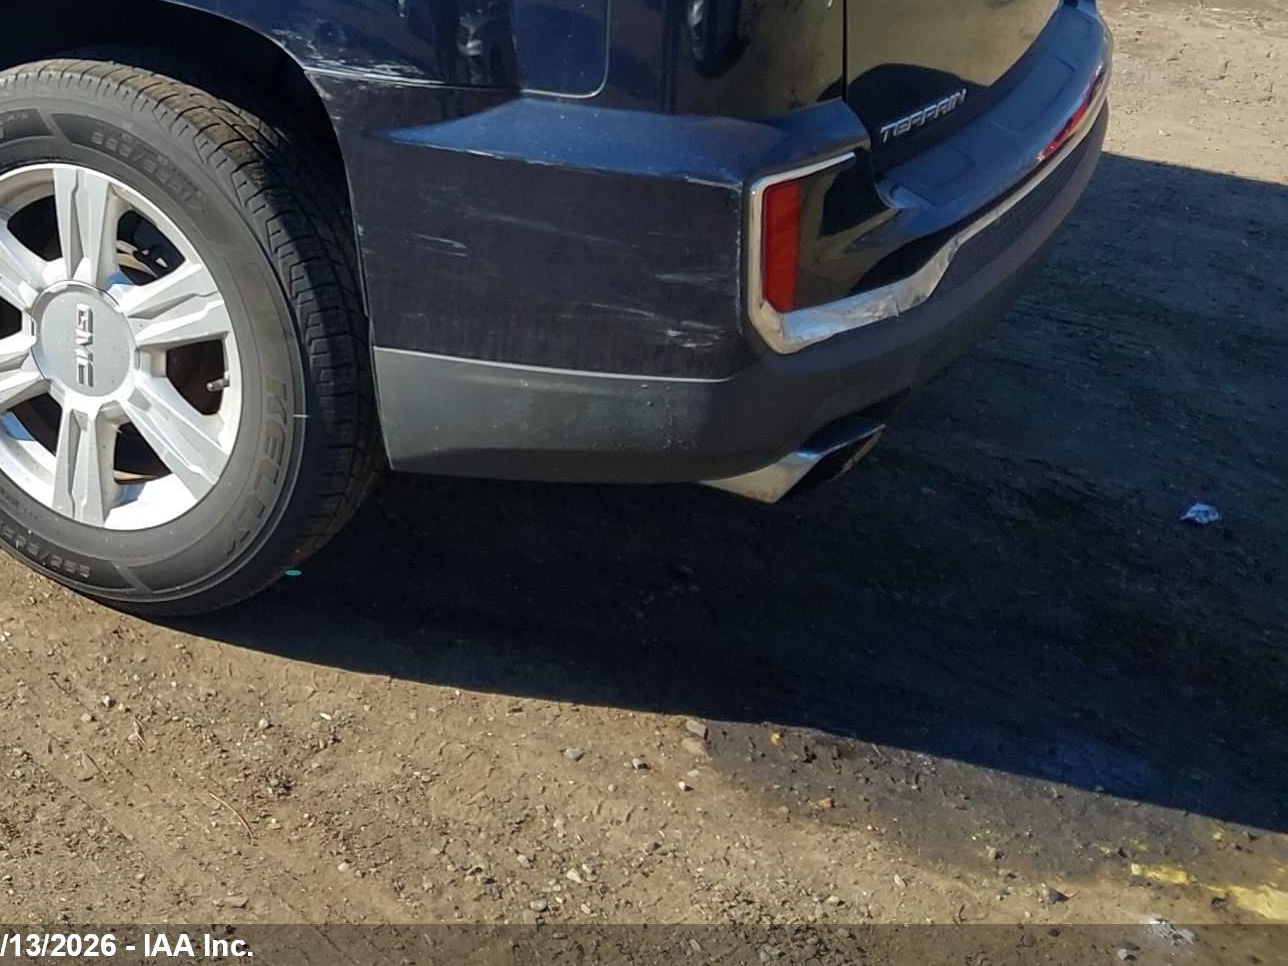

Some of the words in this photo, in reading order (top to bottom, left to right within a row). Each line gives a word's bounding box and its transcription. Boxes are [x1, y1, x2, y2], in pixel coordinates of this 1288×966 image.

[879, 88, 968, 144] TERRAIN
[74, 302, 94, 388] GMC
[224, 375, 289, 556] KELLY
